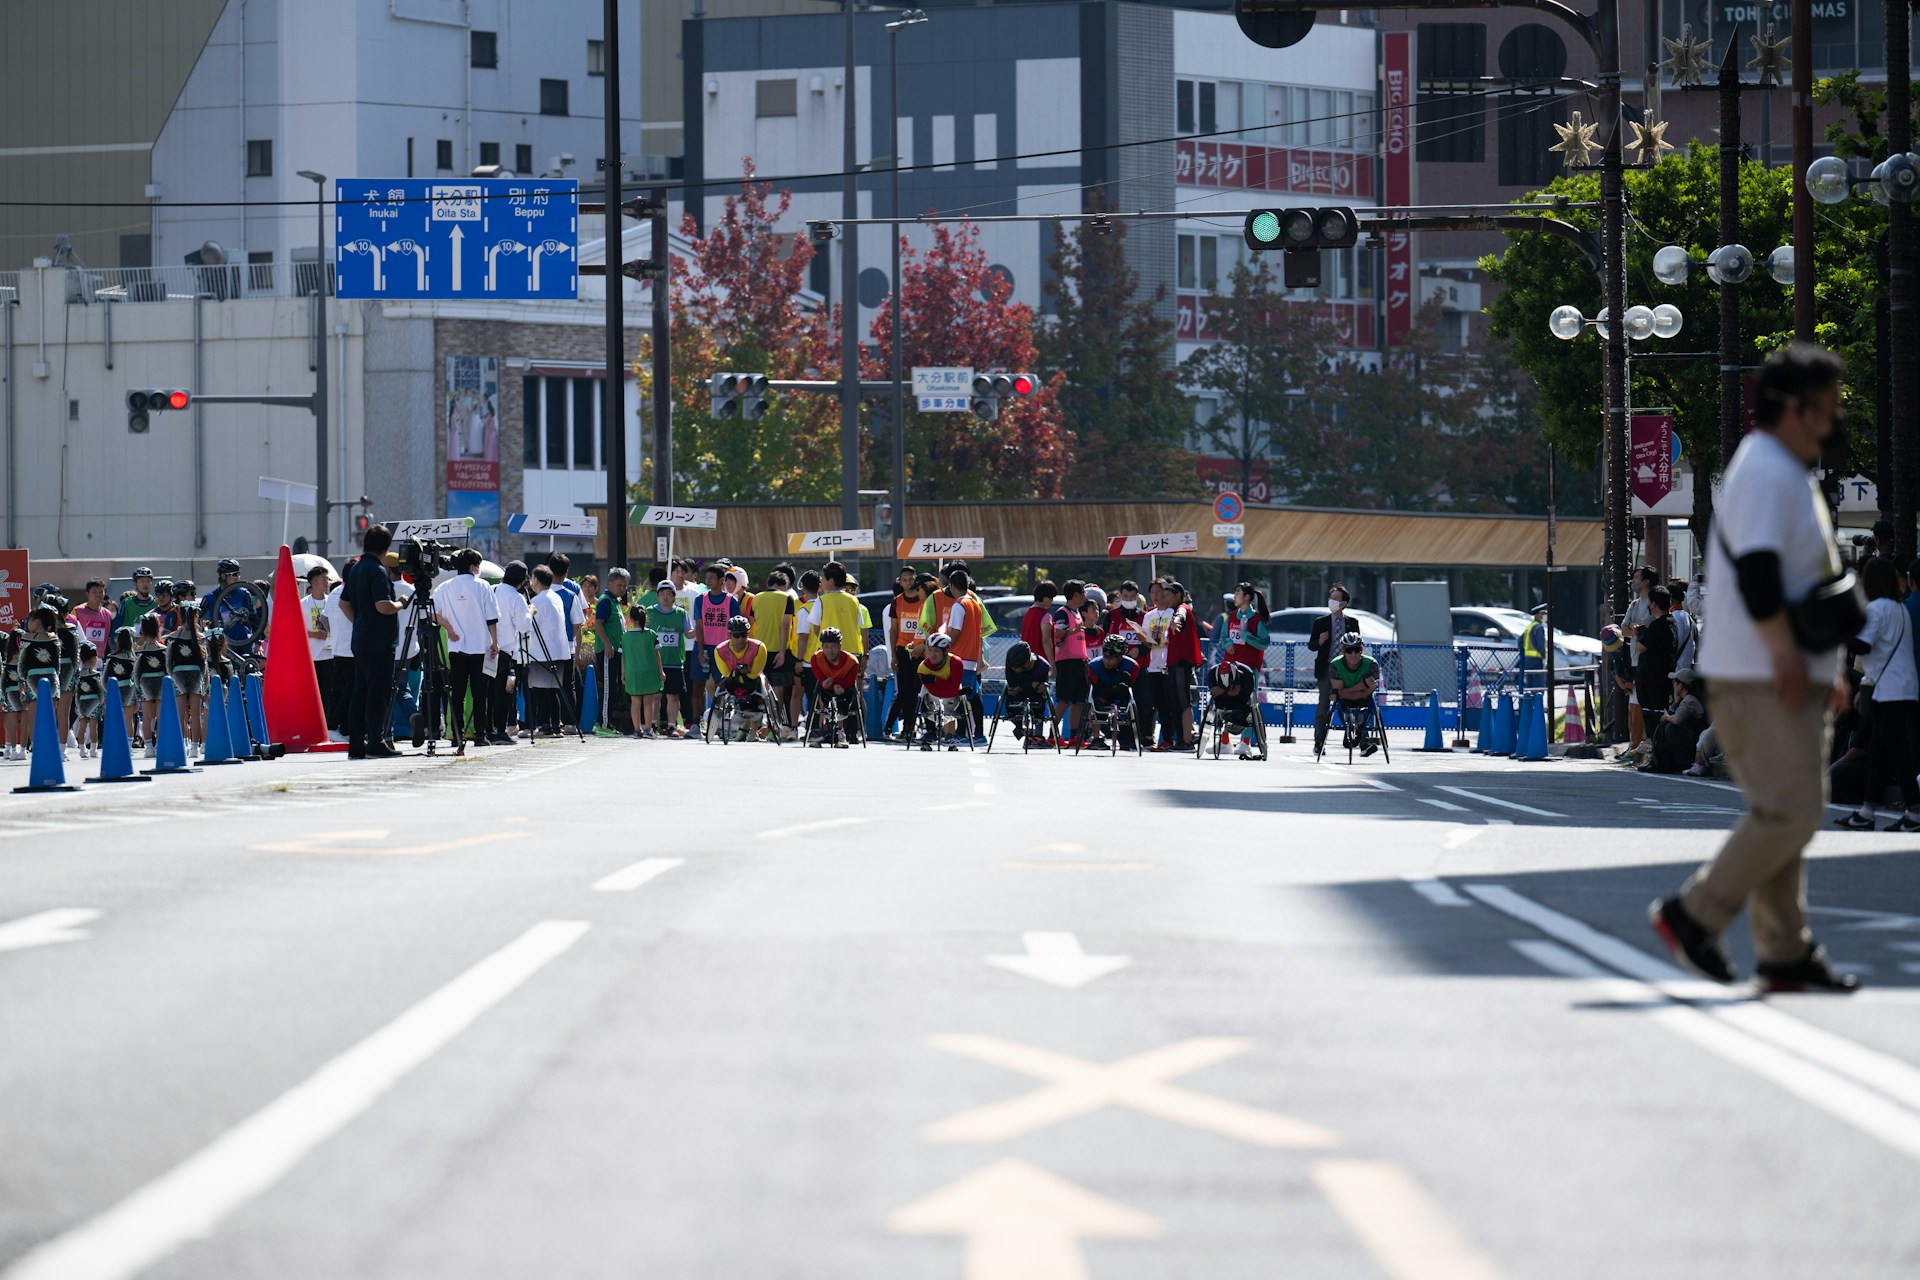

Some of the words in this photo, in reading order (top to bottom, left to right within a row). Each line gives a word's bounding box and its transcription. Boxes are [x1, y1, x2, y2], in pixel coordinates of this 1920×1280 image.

[1724, 6, 1758, 21] TOH
[1773, 2, 1846, 20] CIMAS
[1177, 150, 1241, 179] カラオケ
[362, 188, 405, 206] 犬飼
[435, 189, 478, 206] 大分駅
[508, 187, 550, 205] 別府
[369, 208, 398, 218] Inukai
[436, 208, 456, 218] Oita
[460, 208, 478, 218] Sta.
[514, 207, 545, 219] Beppu
[358, 242, 368, 251] 10
[402, 242, 412, 251] 10
[501, 242, 512, 251] 10
[545, 242, 555, 251] 10
[918, 372, 968, 384] 大分駅前
[1658, 421, 1670, 490] ようこそ大分市へ
[654, 510, 695, 522] グリーン
[401, 523, 452, 537] インディゴ
[538, 518, 571, 530] ブルー
[812, 535, 853, 547] イエロー
[1140, 537, 1169, 550] レッド
[922, 542, 963, 554] オレンジ
[704, 612, 727, 623] 伴走
[906, 620, 918, 629] 08
[92, 629, 102, 637] 09
[663, 634, 675, 643] 05
[1126, 632, 1138, 641] 02
